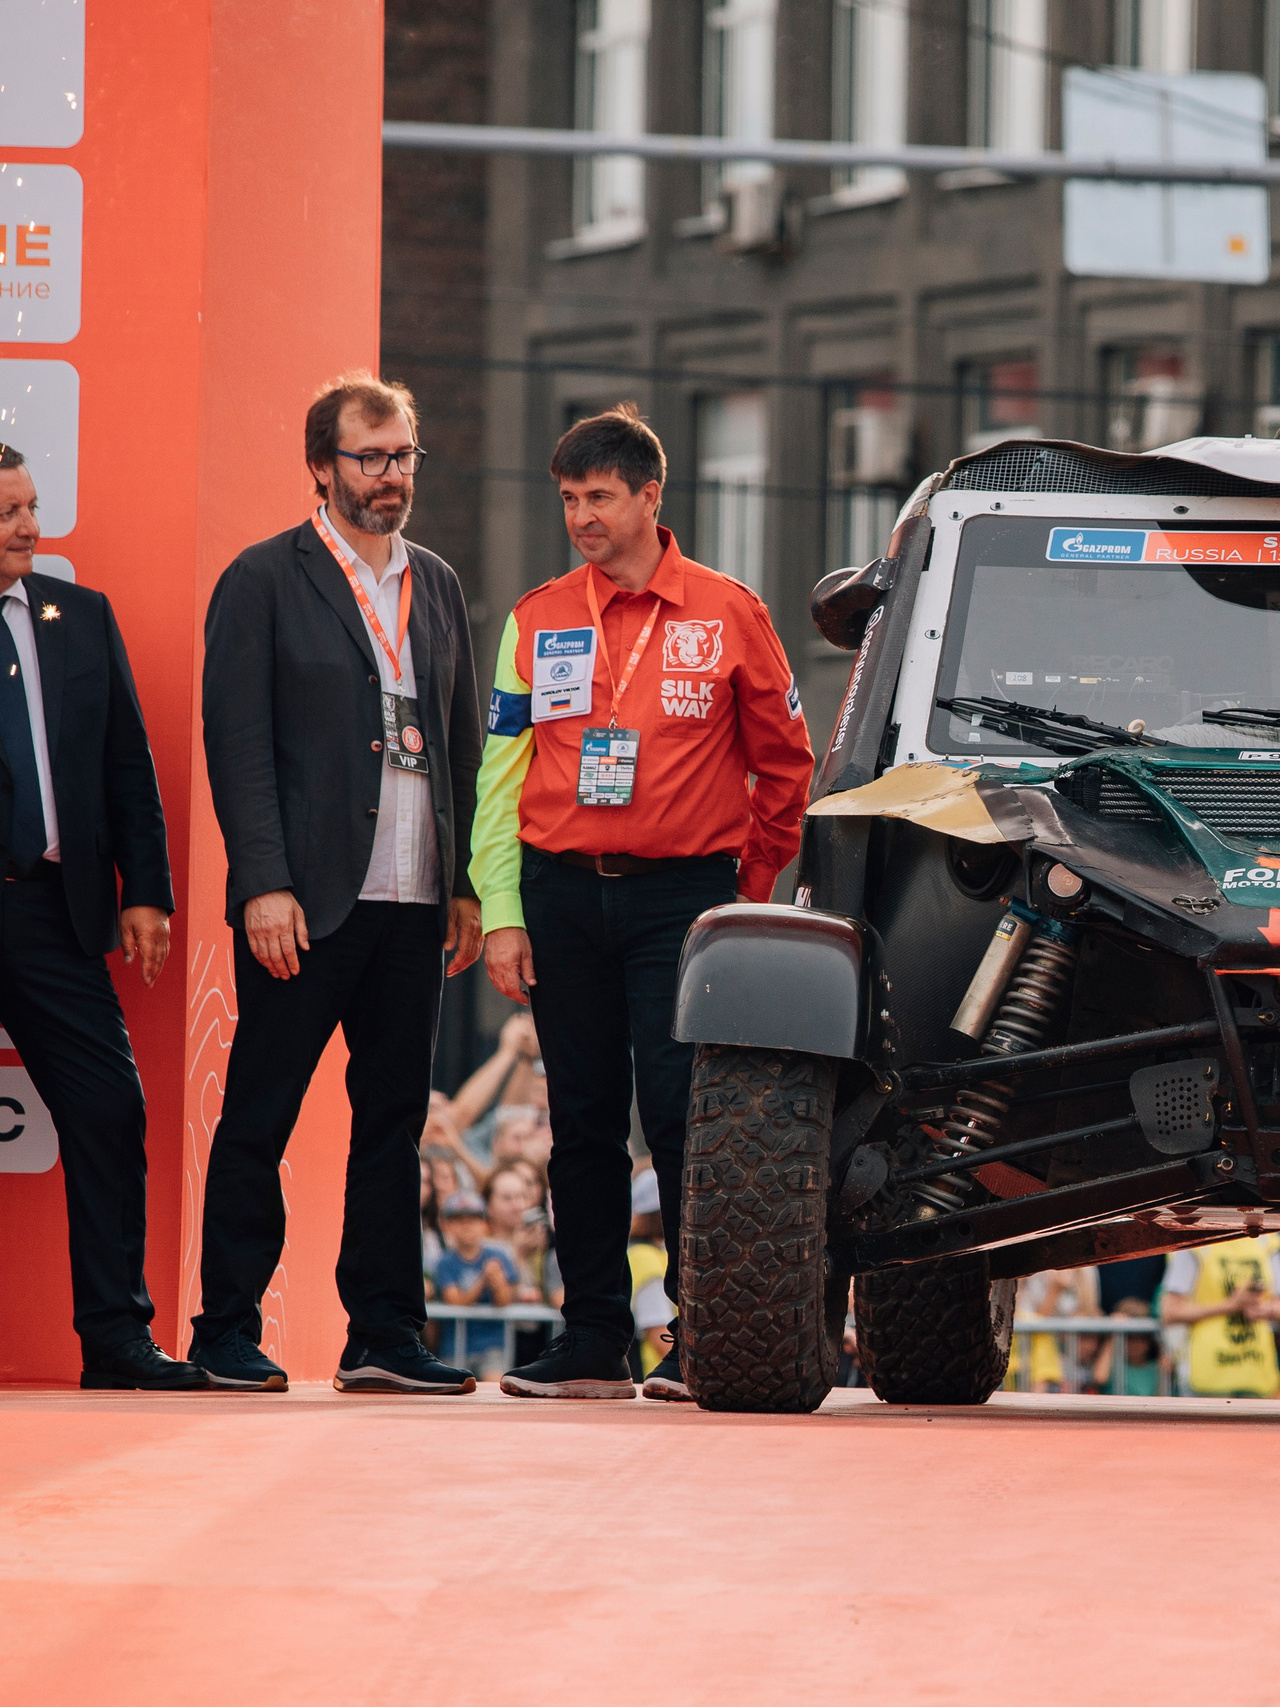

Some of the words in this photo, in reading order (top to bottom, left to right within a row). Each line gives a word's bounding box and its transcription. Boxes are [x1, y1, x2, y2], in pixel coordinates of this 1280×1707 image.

[1082, 544, 1131, 554] GAZPROM
[1155, 548, 1243, 561] RUSSIA
[660, 679, 716, 701] SILK
[660, 697, 714, 719] WAY
[399, 755, 418, 768] VIP
